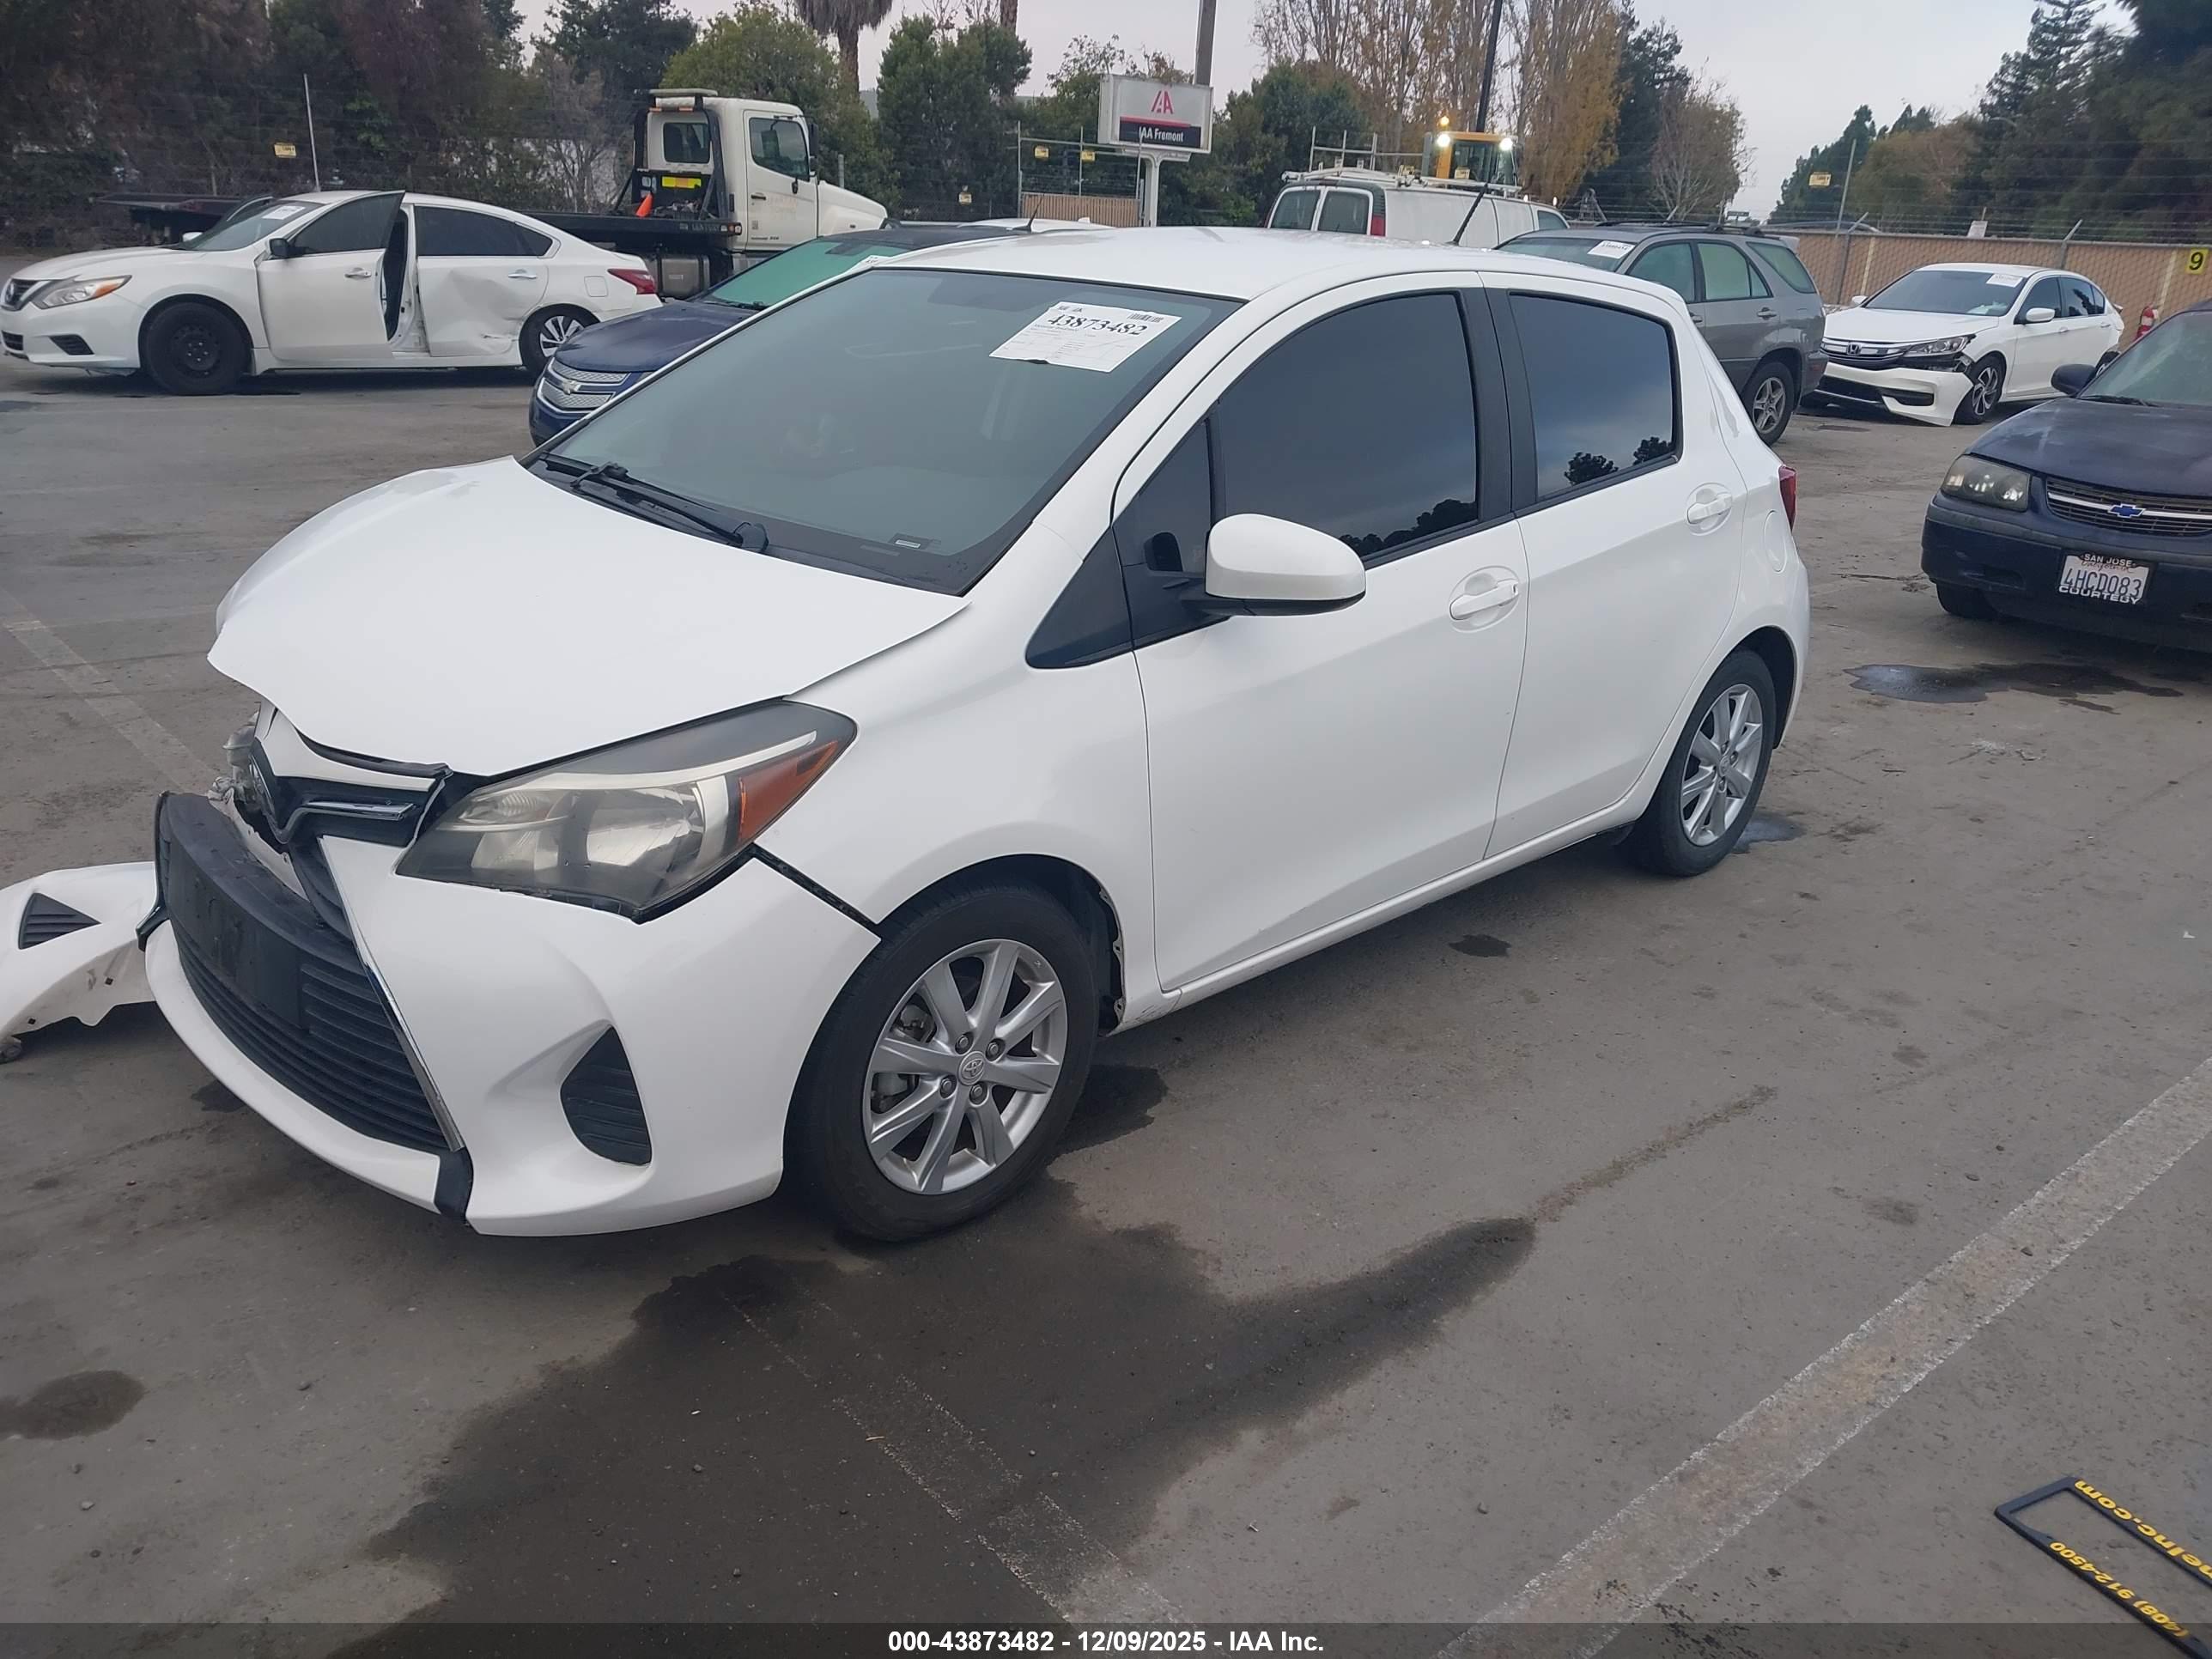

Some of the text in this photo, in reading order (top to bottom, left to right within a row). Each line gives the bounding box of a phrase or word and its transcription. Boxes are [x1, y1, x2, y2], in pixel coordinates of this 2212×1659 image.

[1154, 128, 1184, 143] Fremont
[2189, 252, 2203, 270] 9
[1047, 313, 1148, 336] 43873482
[2083, 553, 2133, 568] SAN JOSE
[2063, 567, 2142, 599] 4HCD083
[2049, 1541, 2190, 1638] (408) 912-4500
